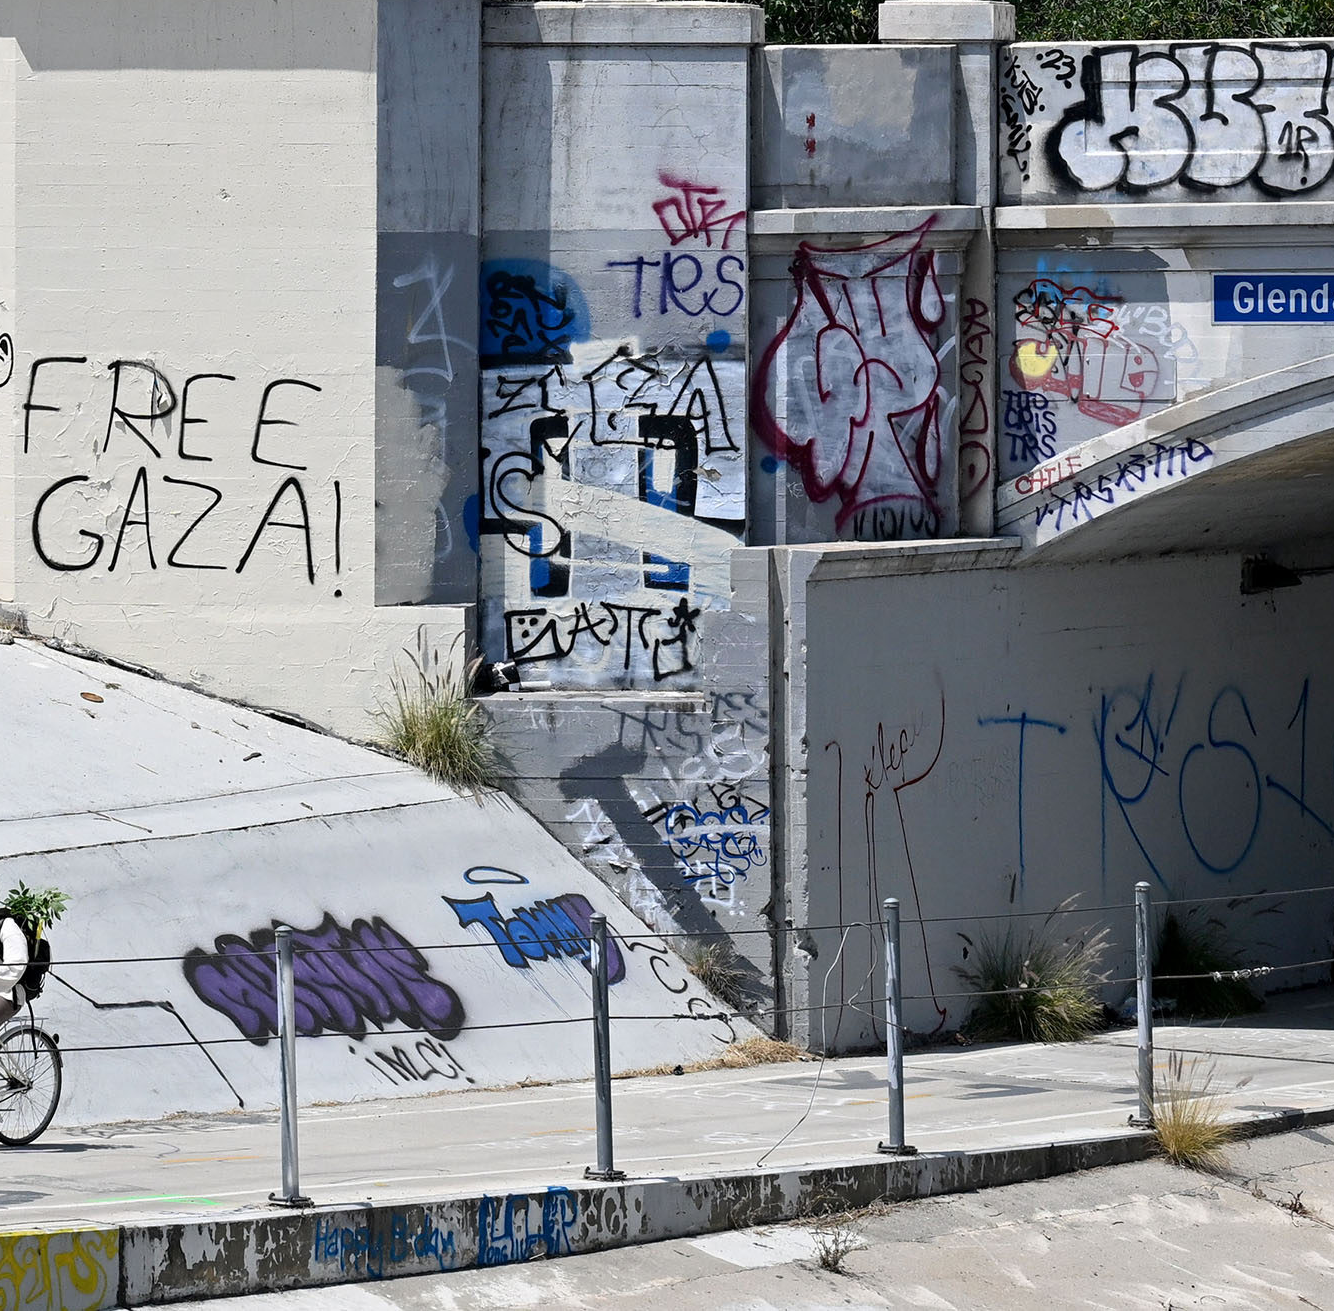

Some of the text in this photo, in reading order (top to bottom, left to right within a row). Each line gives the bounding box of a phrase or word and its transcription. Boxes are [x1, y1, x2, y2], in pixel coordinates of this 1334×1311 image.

[605, 251, 746, 319] TRS
[22, 355, 322, 471] FREE
[30, 465, 344, 598] GAZA!
